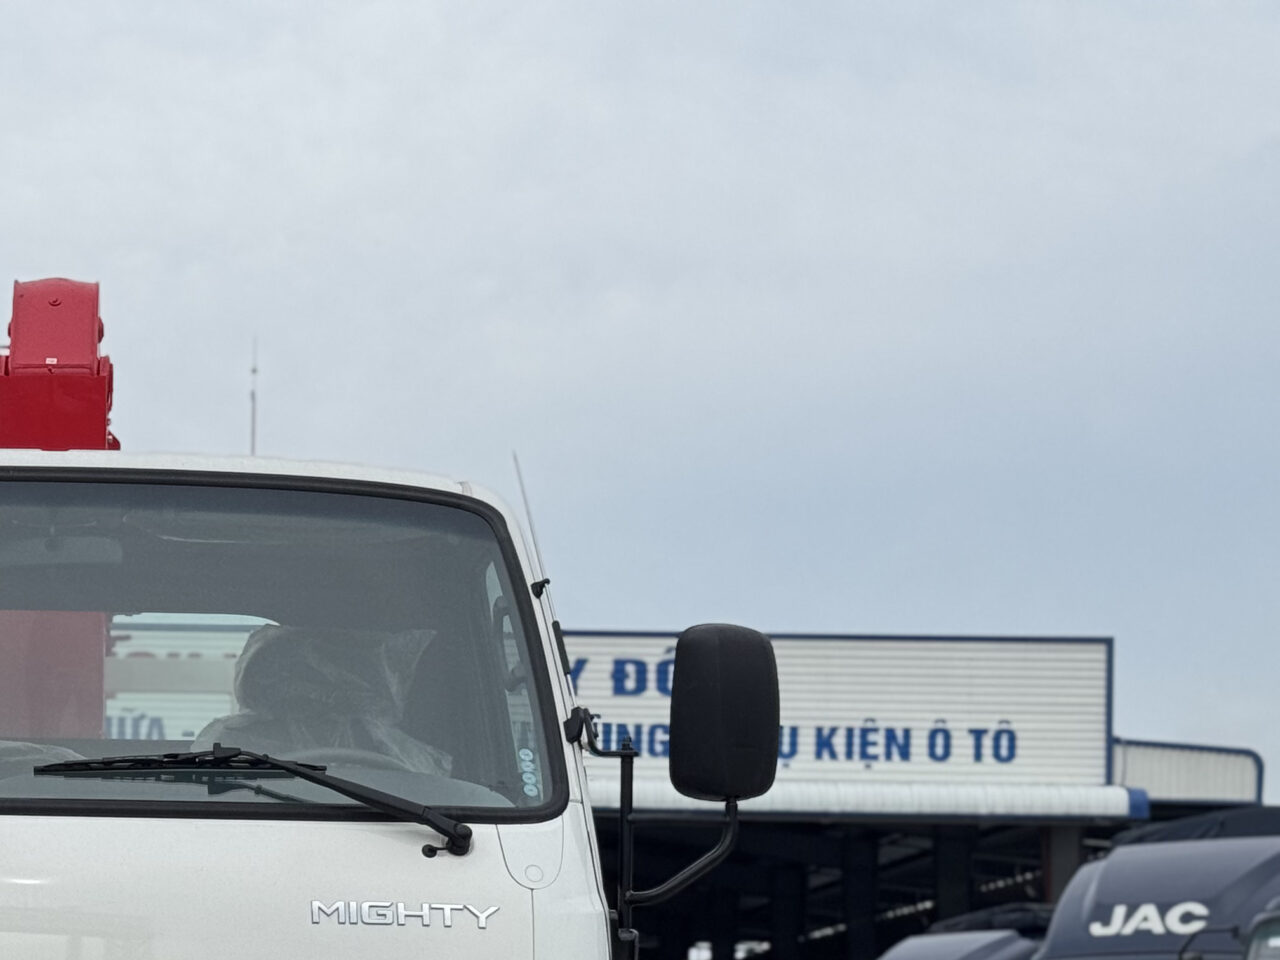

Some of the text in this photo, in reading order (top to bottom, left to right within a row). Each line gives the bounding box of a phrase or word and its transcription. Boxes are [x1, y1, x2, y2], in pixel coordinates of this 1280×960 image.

[815, 718, 912, 769] KIỆN
[928, 719, 952, 762] Ô
[968, 720, 1017, 763] TÔ
[311, 900, 500, 928] MIGHTY
[1088, 901, 1210, 937] JAC
